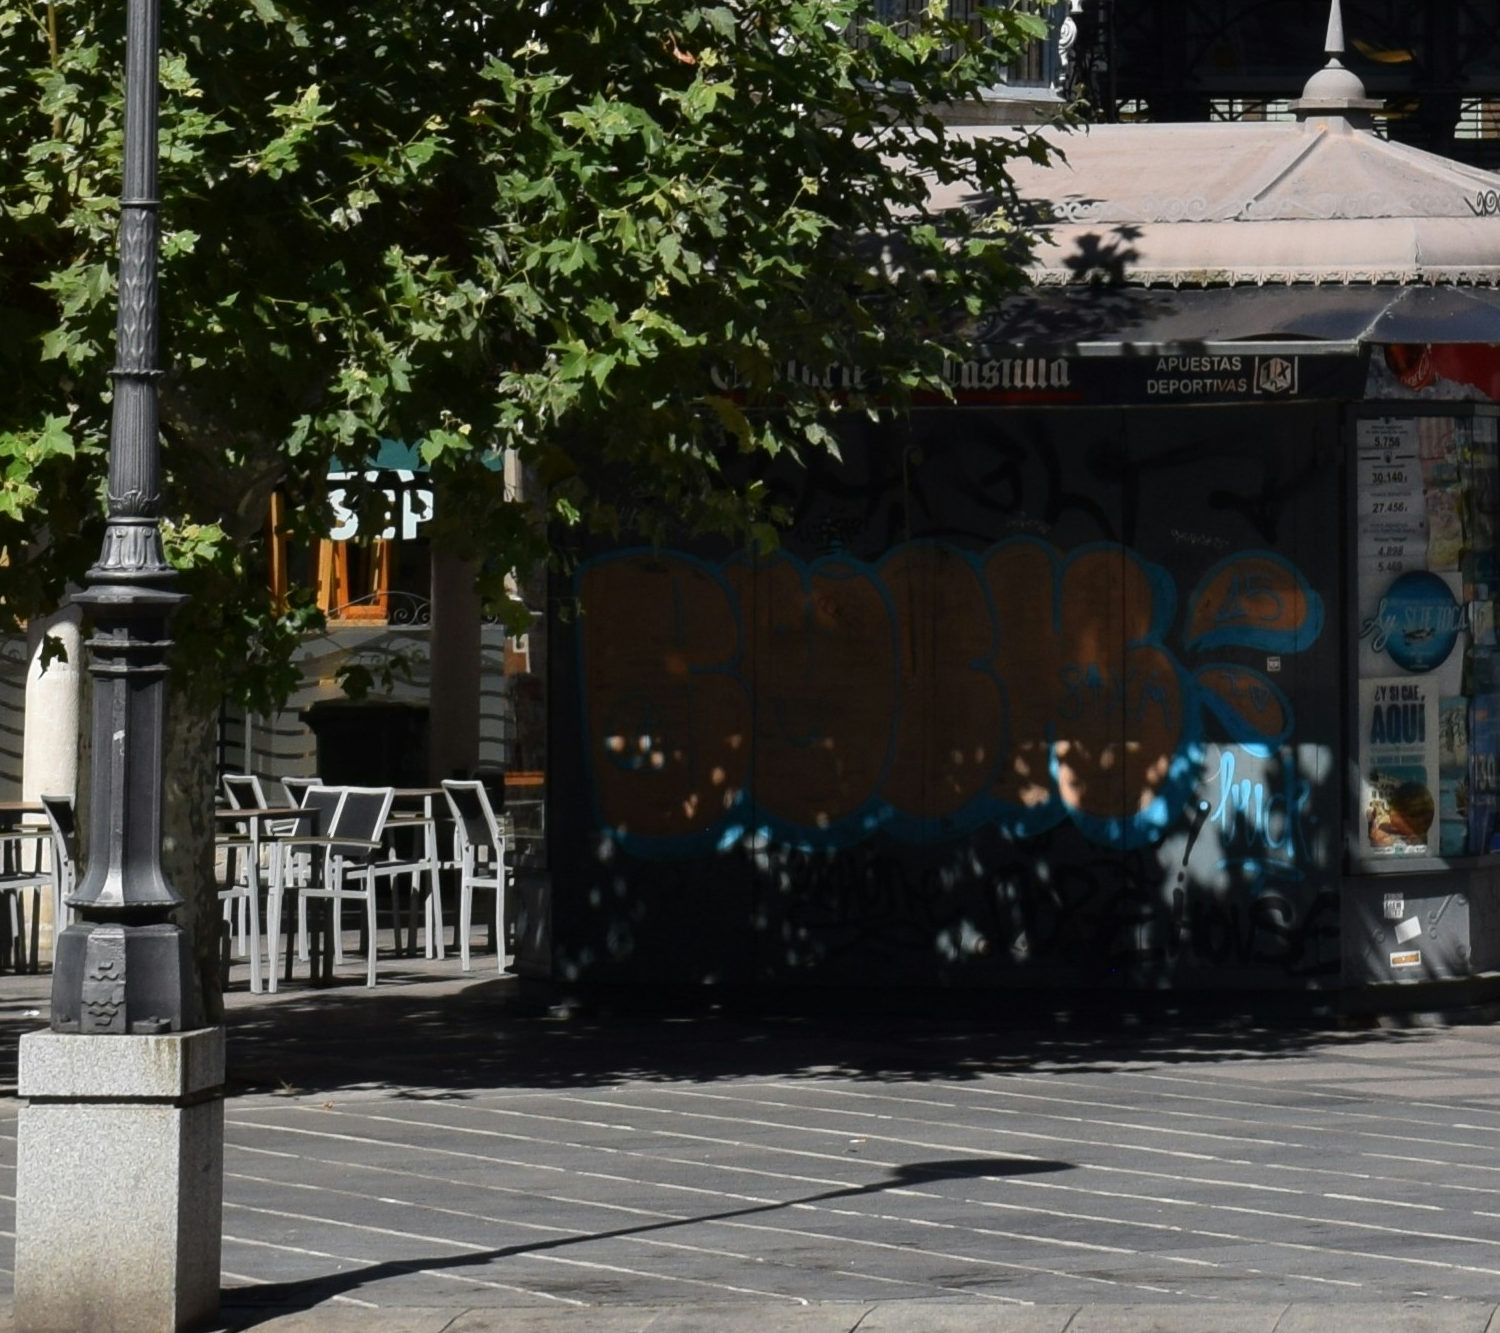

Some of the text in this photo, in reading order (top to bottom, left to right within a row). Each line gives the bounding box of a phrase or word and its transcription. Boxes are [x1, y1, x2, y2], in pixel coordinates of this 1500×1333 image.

[1155, 356, 1243, 372] APUESTAS
[1146, 378, 1248, 395] DEPORTIVAS
[1374, 684, 1419, 702] ¿Y SI CAE
